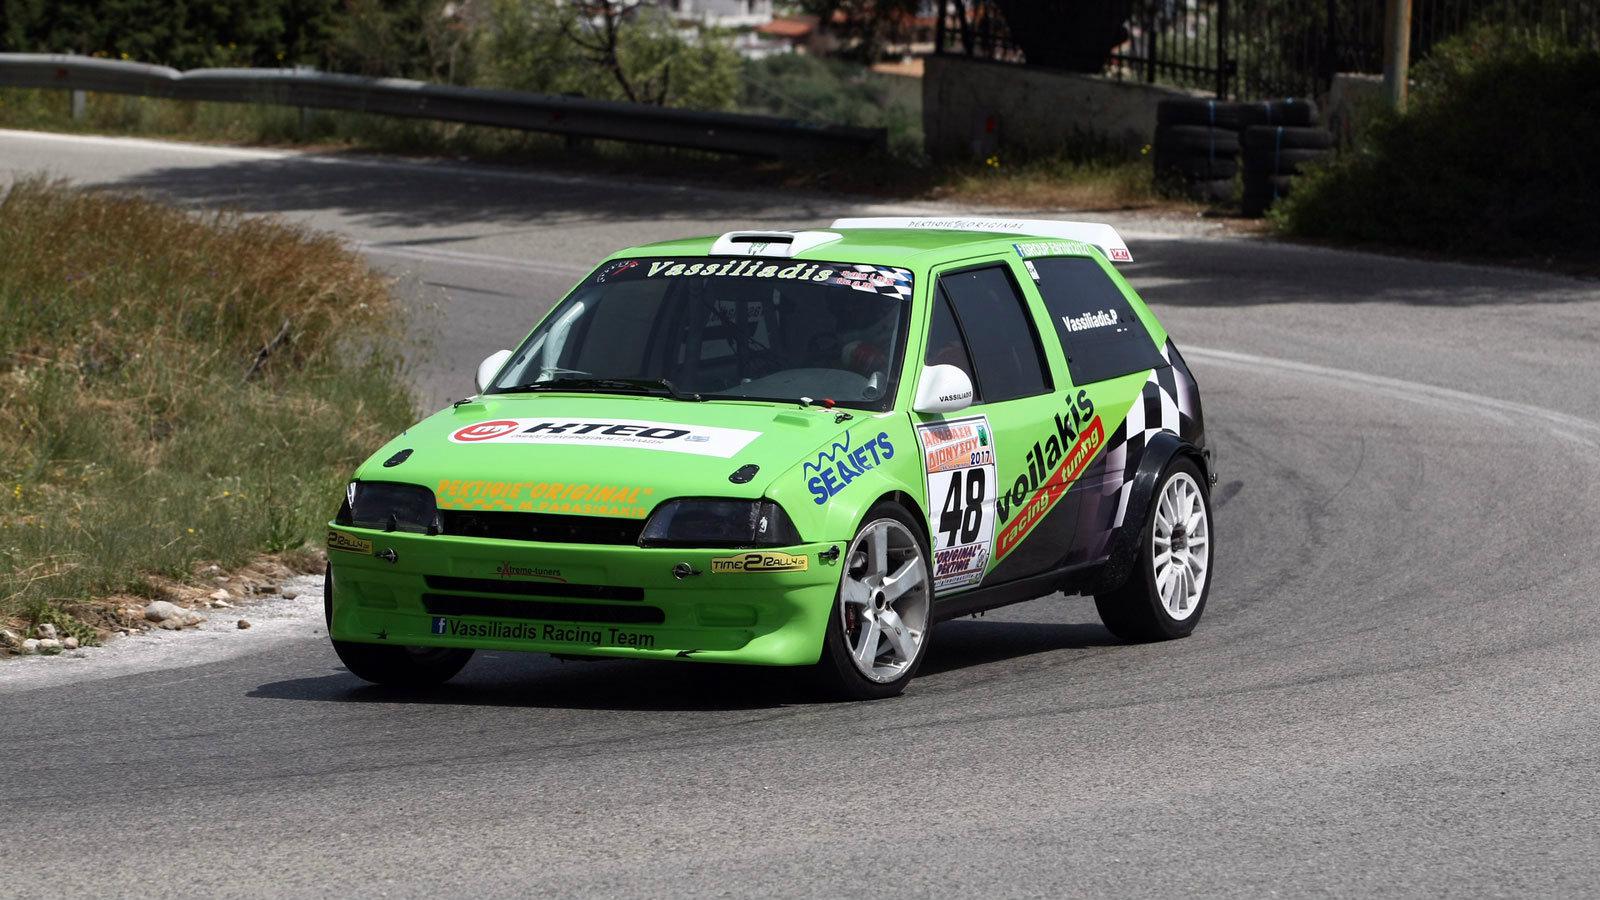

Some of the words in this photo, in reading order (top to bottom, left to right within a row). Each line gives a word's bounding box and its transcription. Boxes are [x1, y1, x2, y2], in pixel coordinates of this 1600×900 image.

[647, 259, 834, 282] Vassiliadis
[970, 450, 990, 465] 2017
[996, 389, 1094, 524] voilakis
[939, 467, 985, 548] 48
[1002, 491, 1050, 549] racing
[1061, 426, 1099, 482] tuning
[450, 620, 537, 639] Vassiliadis
[543, 624, 601, 646] Racing
[609, 627, 655, 646] Team
